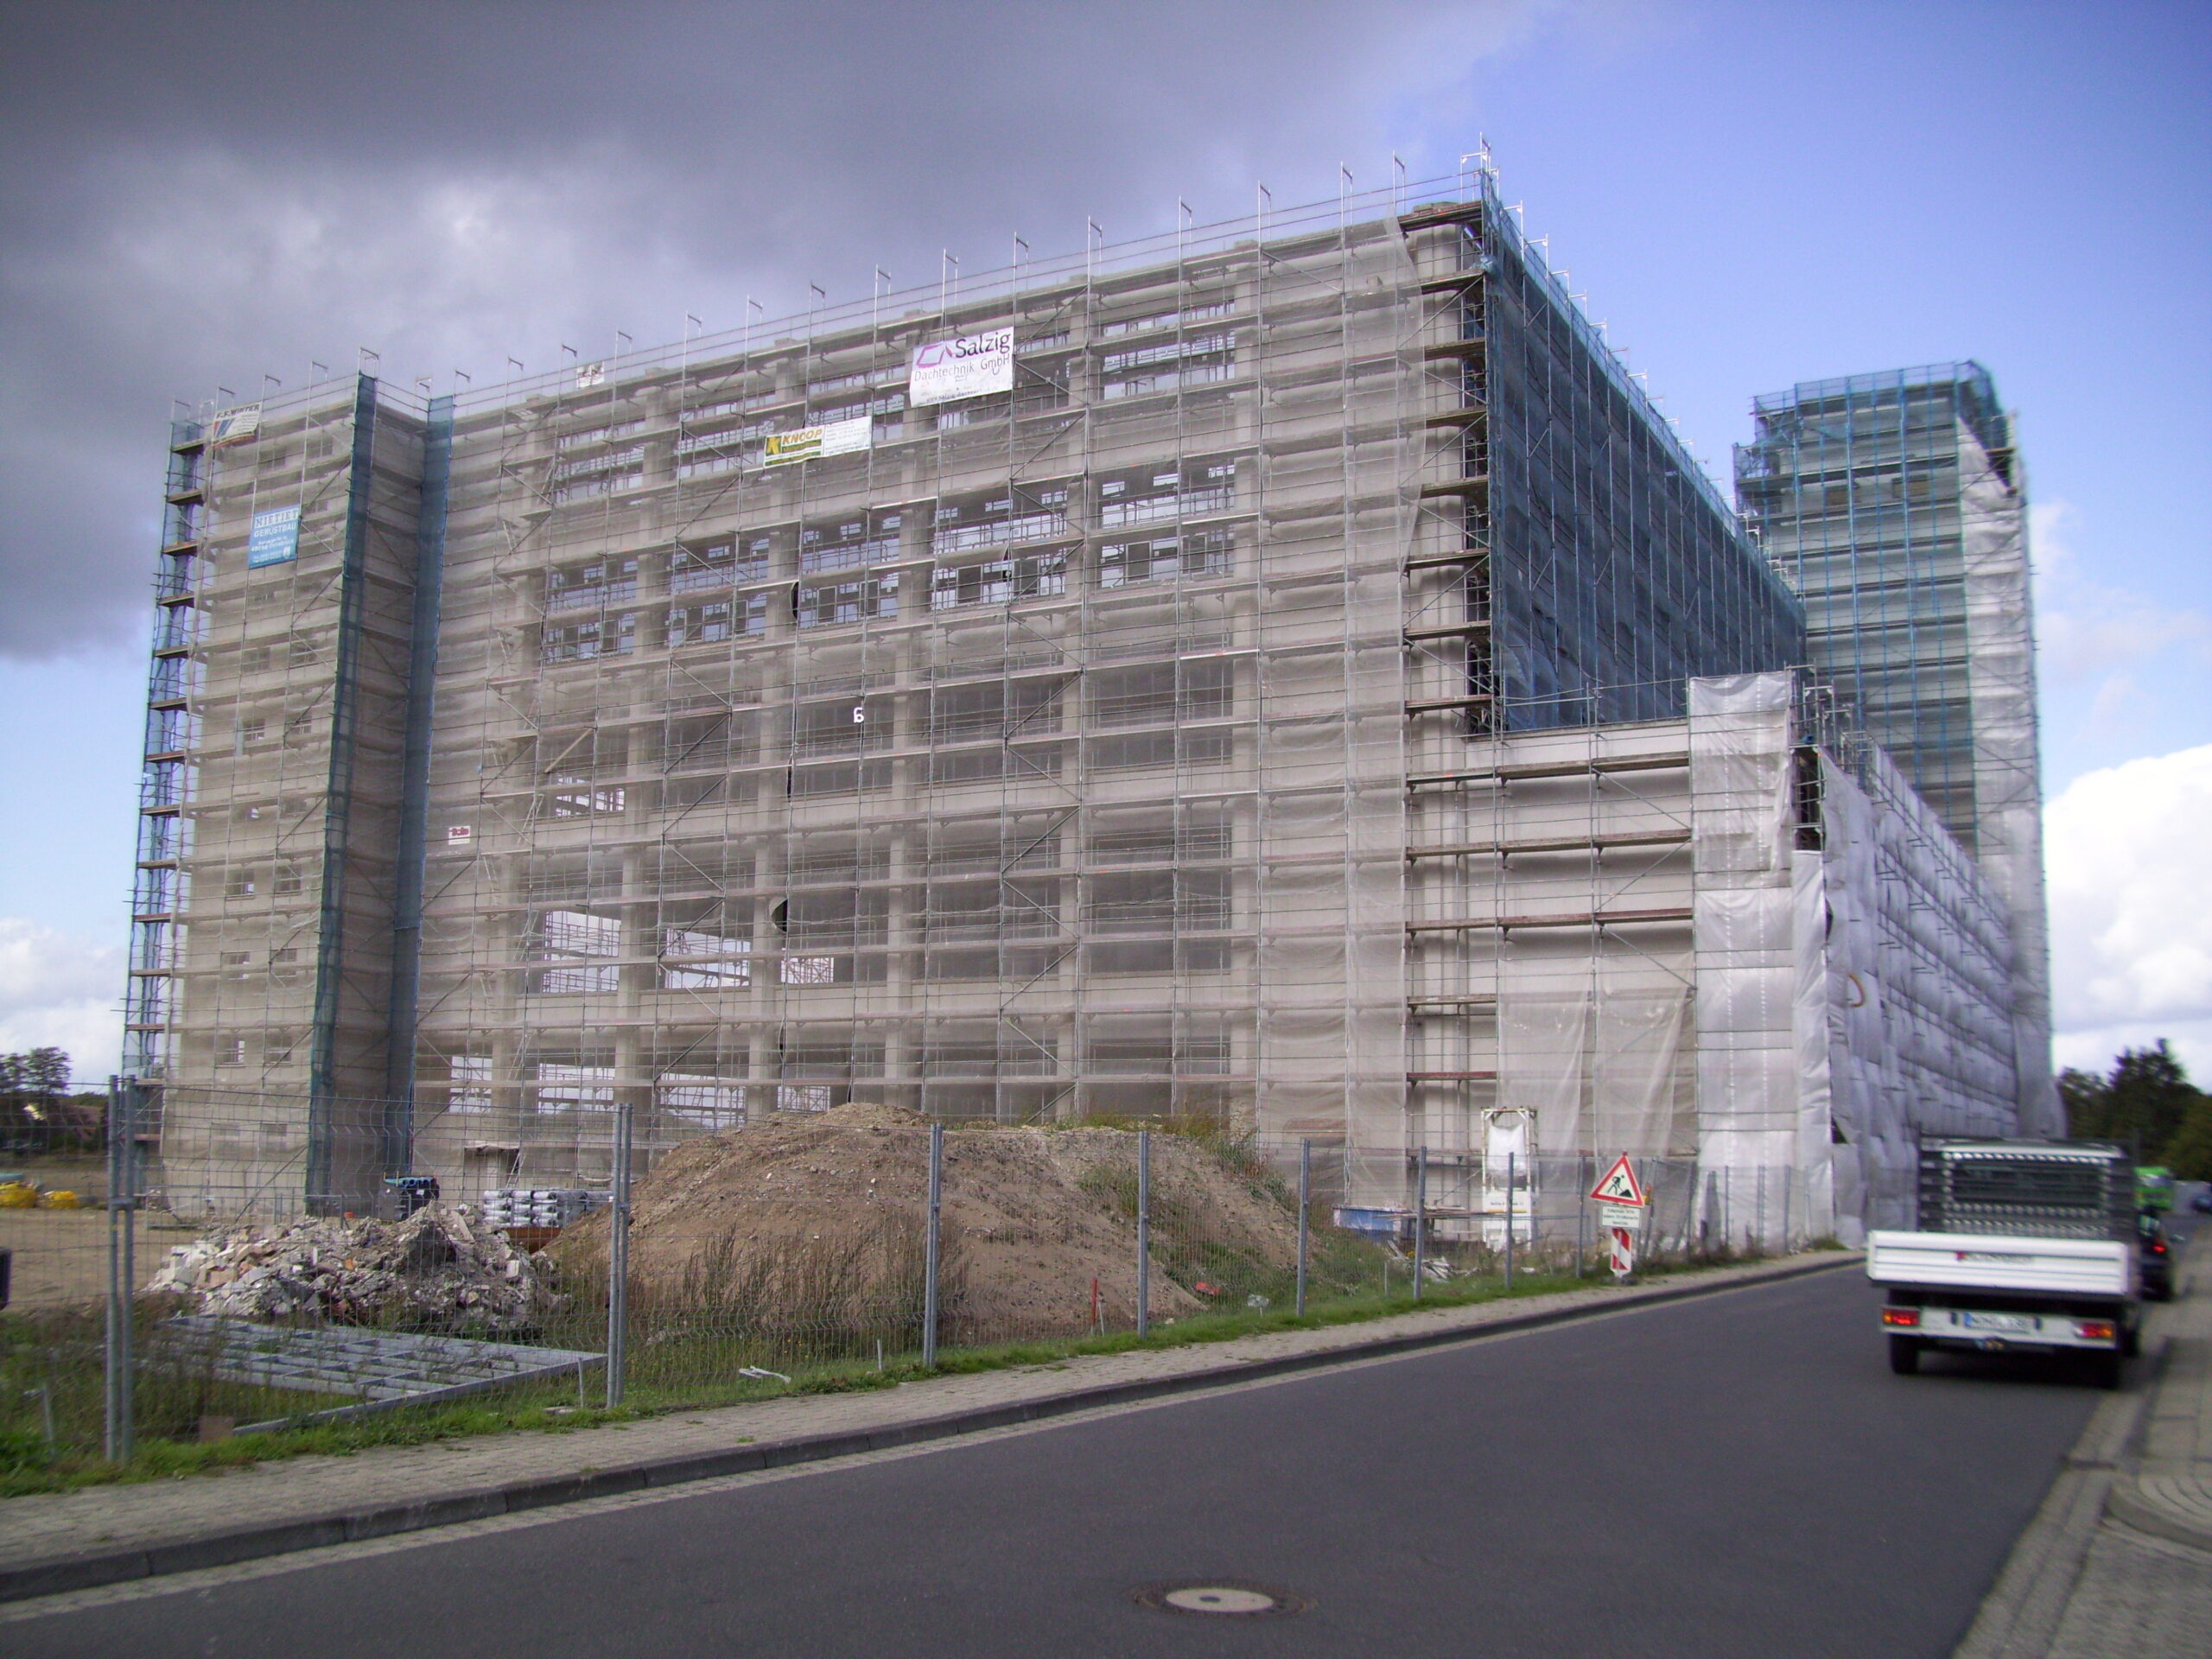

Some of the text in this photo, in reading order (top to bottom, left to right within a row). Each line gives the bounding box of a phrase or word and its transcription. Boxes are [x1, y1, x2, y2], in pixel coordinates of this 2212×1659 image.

[955, 332, 1011, 359] Salzig
[914, 353, 1010, 382] Dachtechnik GmbH
